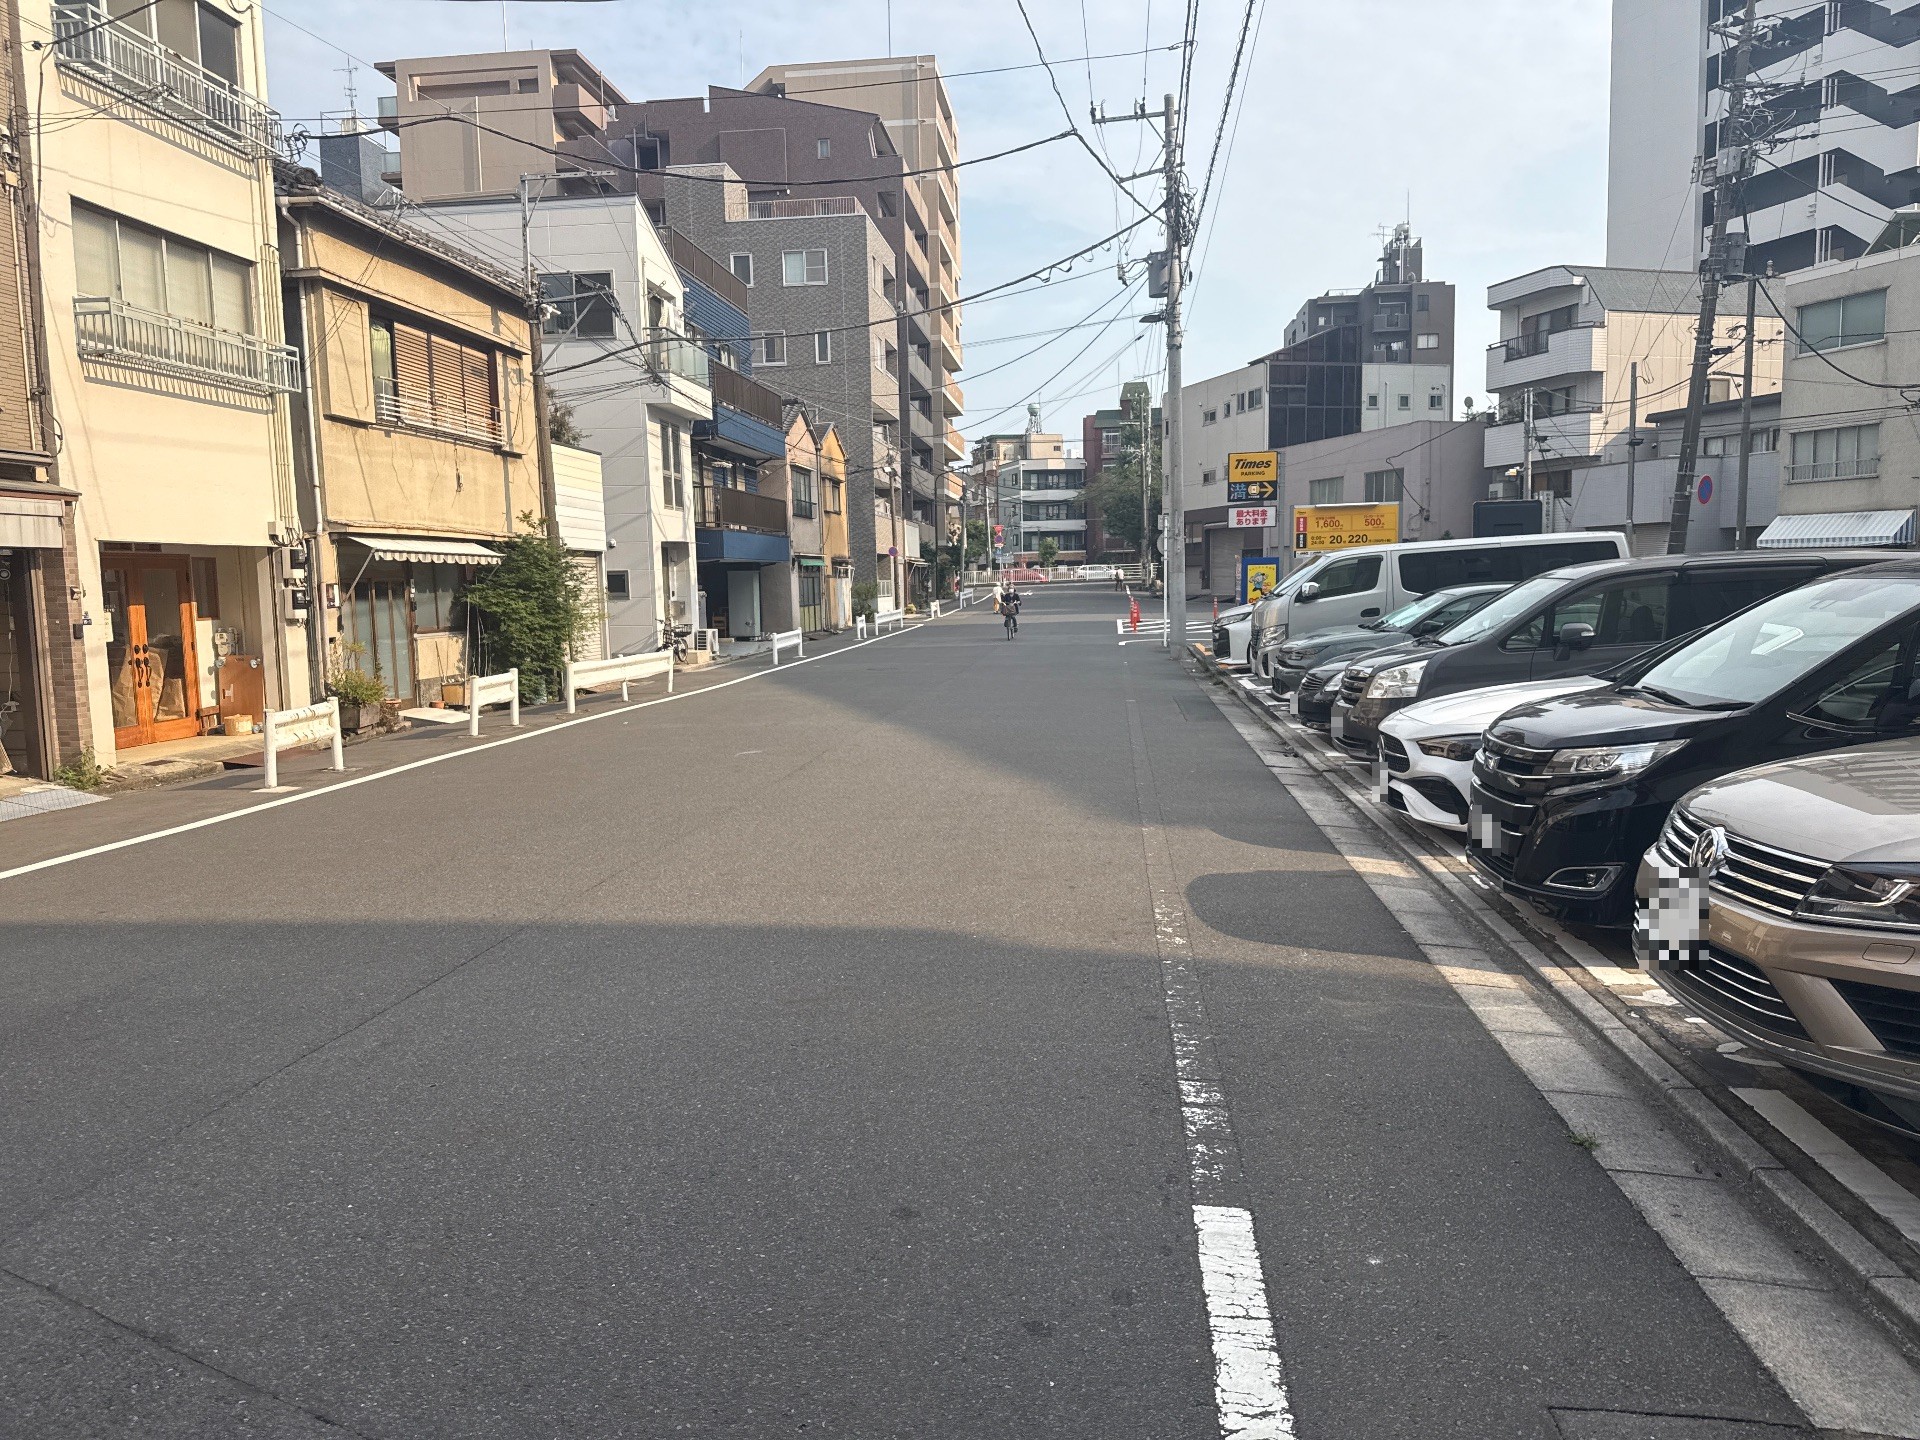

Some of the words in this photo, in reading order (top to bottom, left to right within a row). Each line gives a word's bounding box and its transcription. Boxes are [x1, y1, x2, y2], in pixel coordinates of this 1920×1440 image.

[1234, 459, 1272, 469] Times
[1230, 484, 1246, 500] 満
[1236, 509, 1268, 518] 最大料金
[1236, 518, 1268, 526] あります
